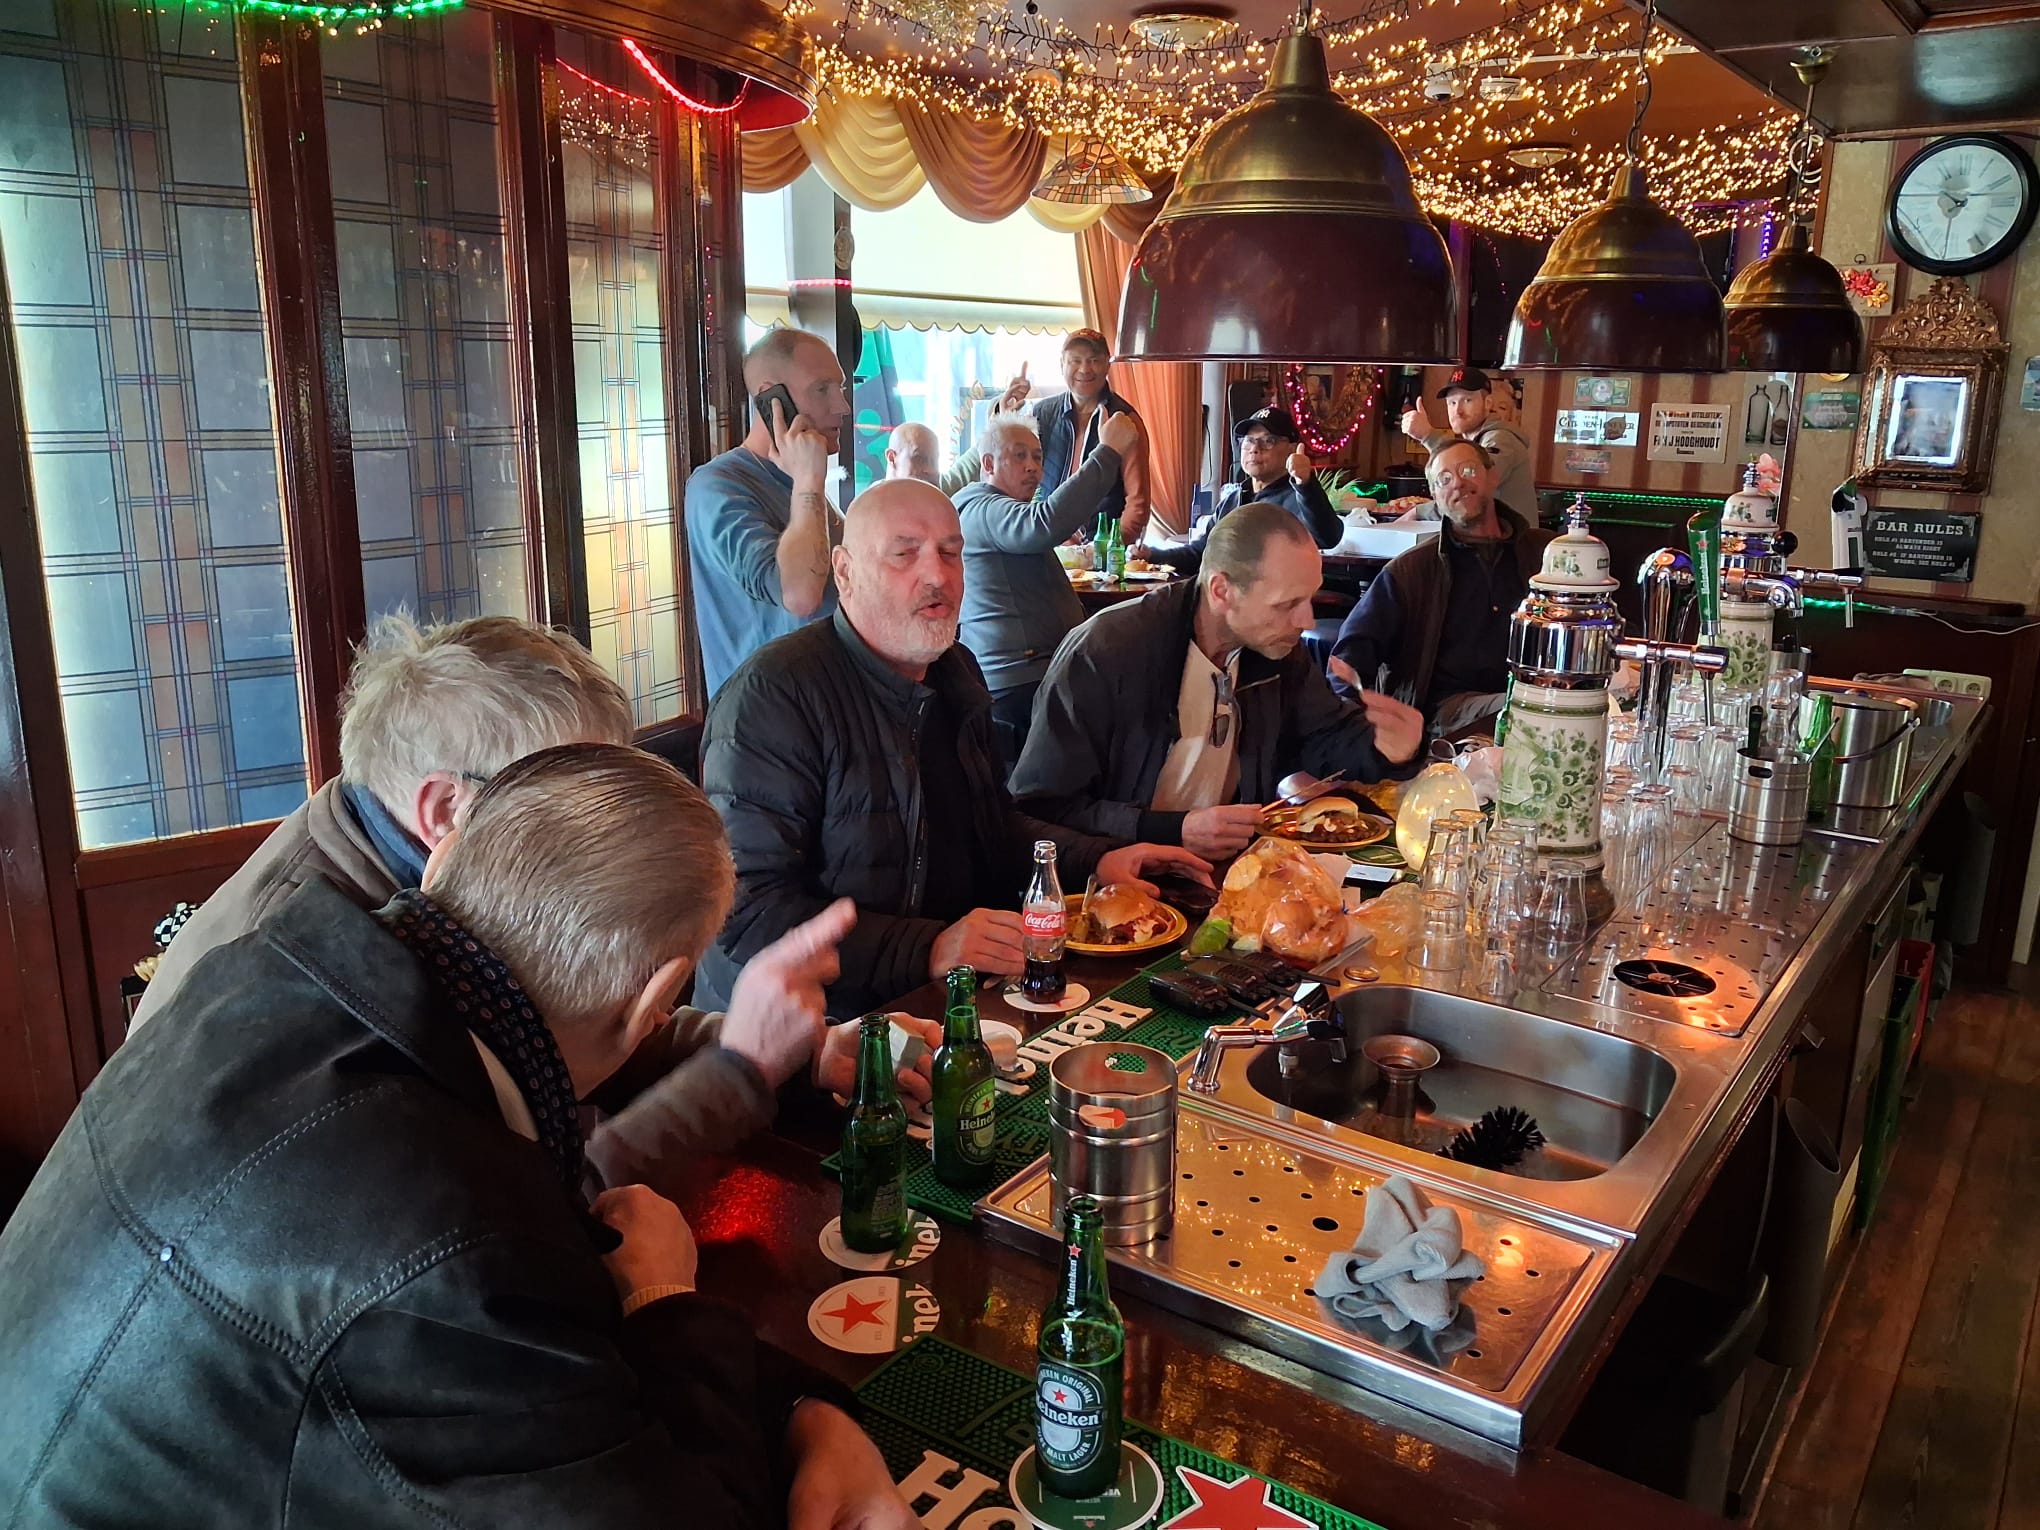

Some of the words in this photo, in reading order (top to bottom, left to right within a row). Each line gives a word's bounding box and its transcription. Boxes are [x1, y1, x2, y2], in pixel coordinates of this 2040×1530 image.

[1876, 521, 1908, 532] BAR
[1913, 523, 1964, 535] RULES
[1066, 1259, 1077, 1306] Heineken
[1062, 1375, 1094, 1404] ORIGINAL
[1039, 1400, 1099, 1427] eineken
[1046, 1447, 1066, 1462] MALT
[1069, 1441, 1092, 1462] LAGER
